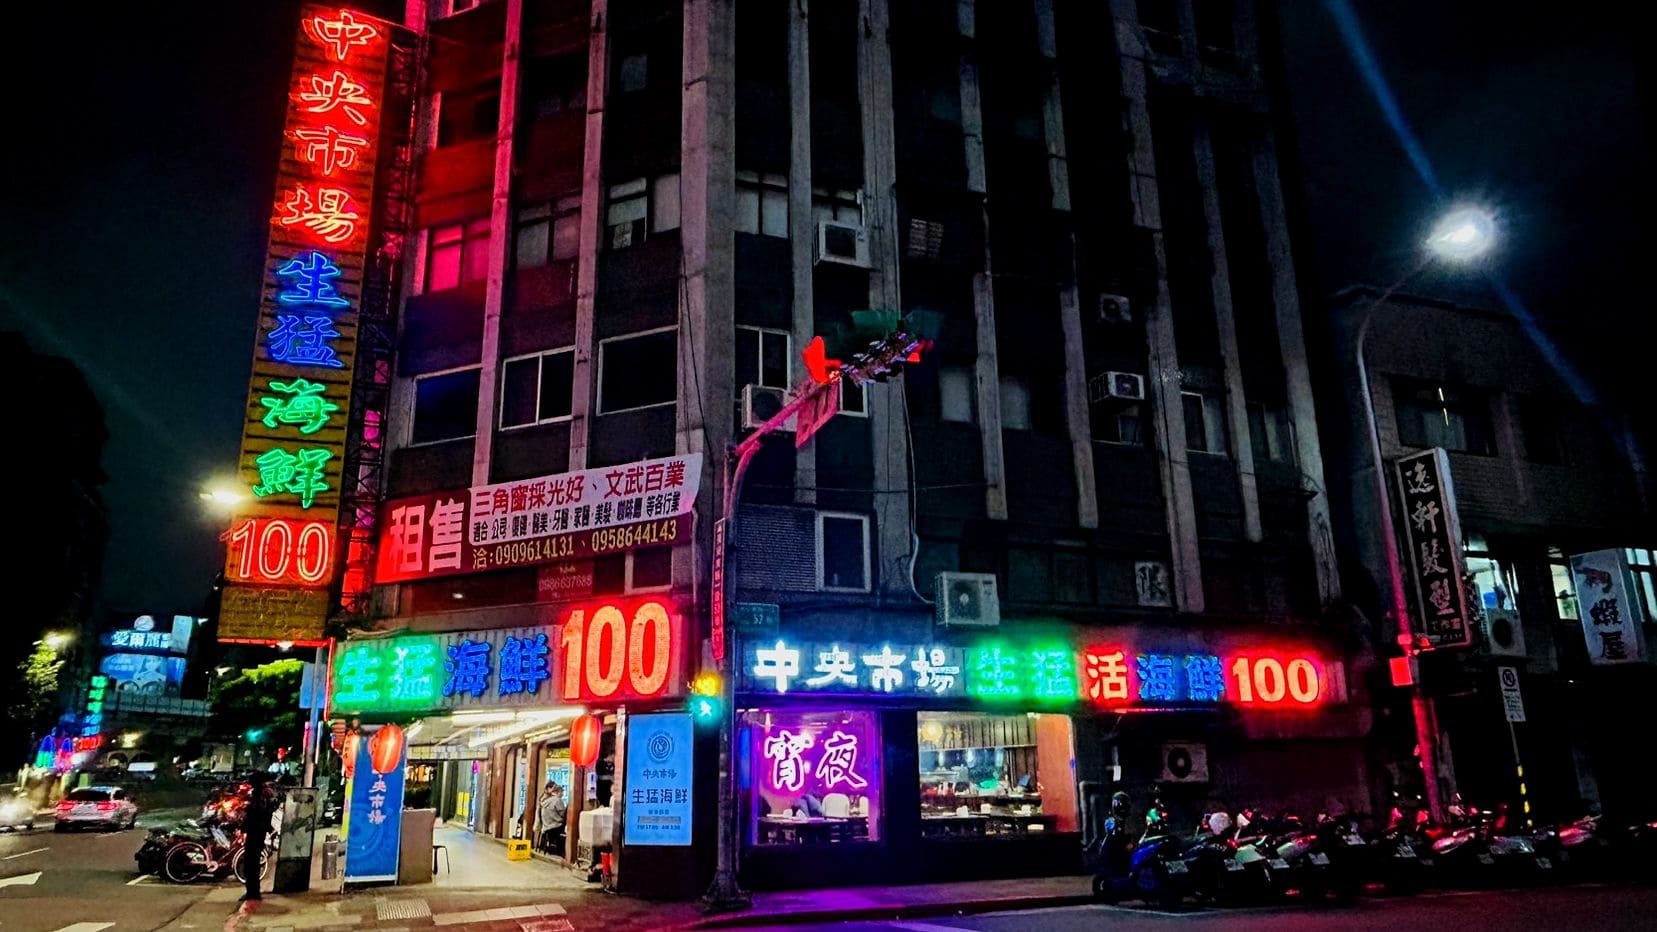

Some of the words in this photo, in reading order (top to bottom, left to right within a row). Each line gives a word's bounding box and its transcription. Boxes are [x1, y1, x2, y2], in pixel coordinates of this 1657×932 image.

[229, 519, 331, 583] 100
[389, 498, 465, 575] 租售
[591, 519, 678, 552] 0958644143
[334, 633, 551, 704] 生猛海鮮
[559, 602, 670, 700] 100
[1230, 656, 1320, 703] 100
[763, 729, 868, 792] 宵夜
[631, 787, 689, 804] 生猛海鮮
